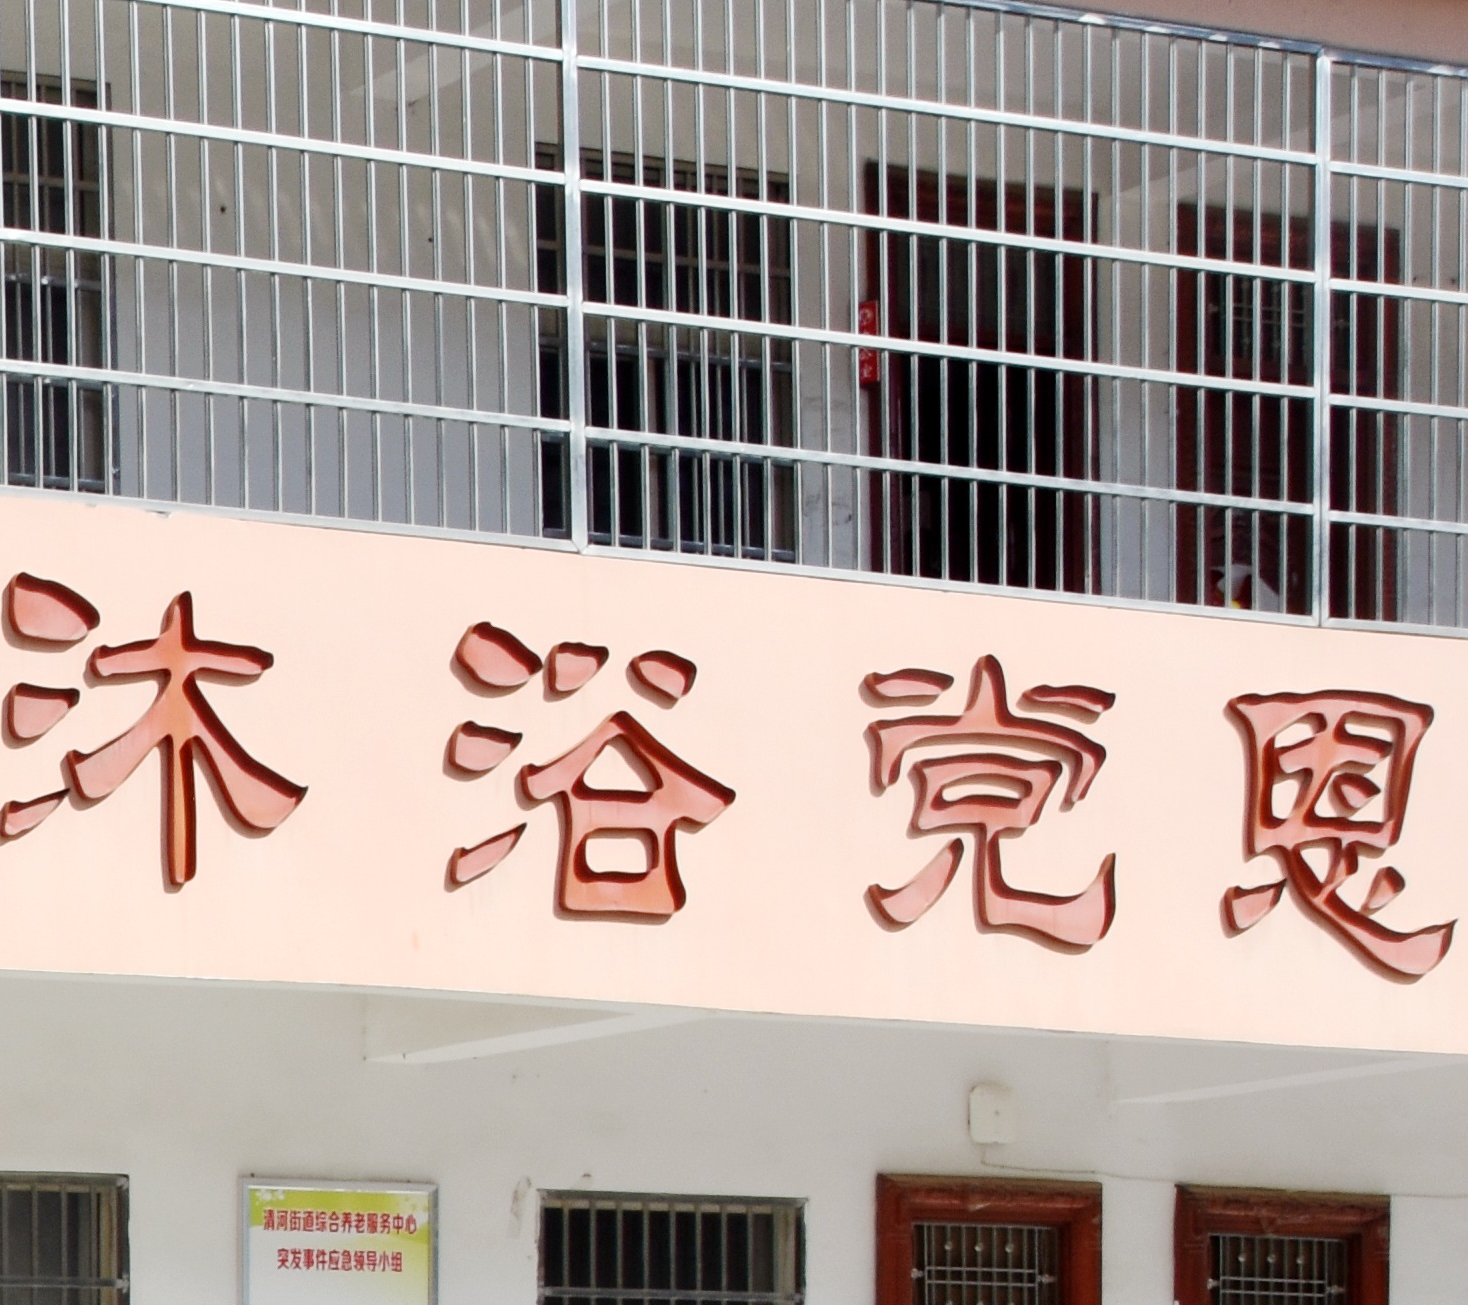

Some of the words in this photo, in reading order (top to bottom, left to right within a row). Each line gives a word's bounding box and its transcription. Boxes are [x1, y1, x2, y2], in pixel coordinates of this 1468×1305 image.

[2, 573, 1457, 979] 沐浴党恩
[263, 1209, 417, 1235] 清河街道综合养老服务中心
[277, 1248, 403, 1272] 突发事件应急领导小组
